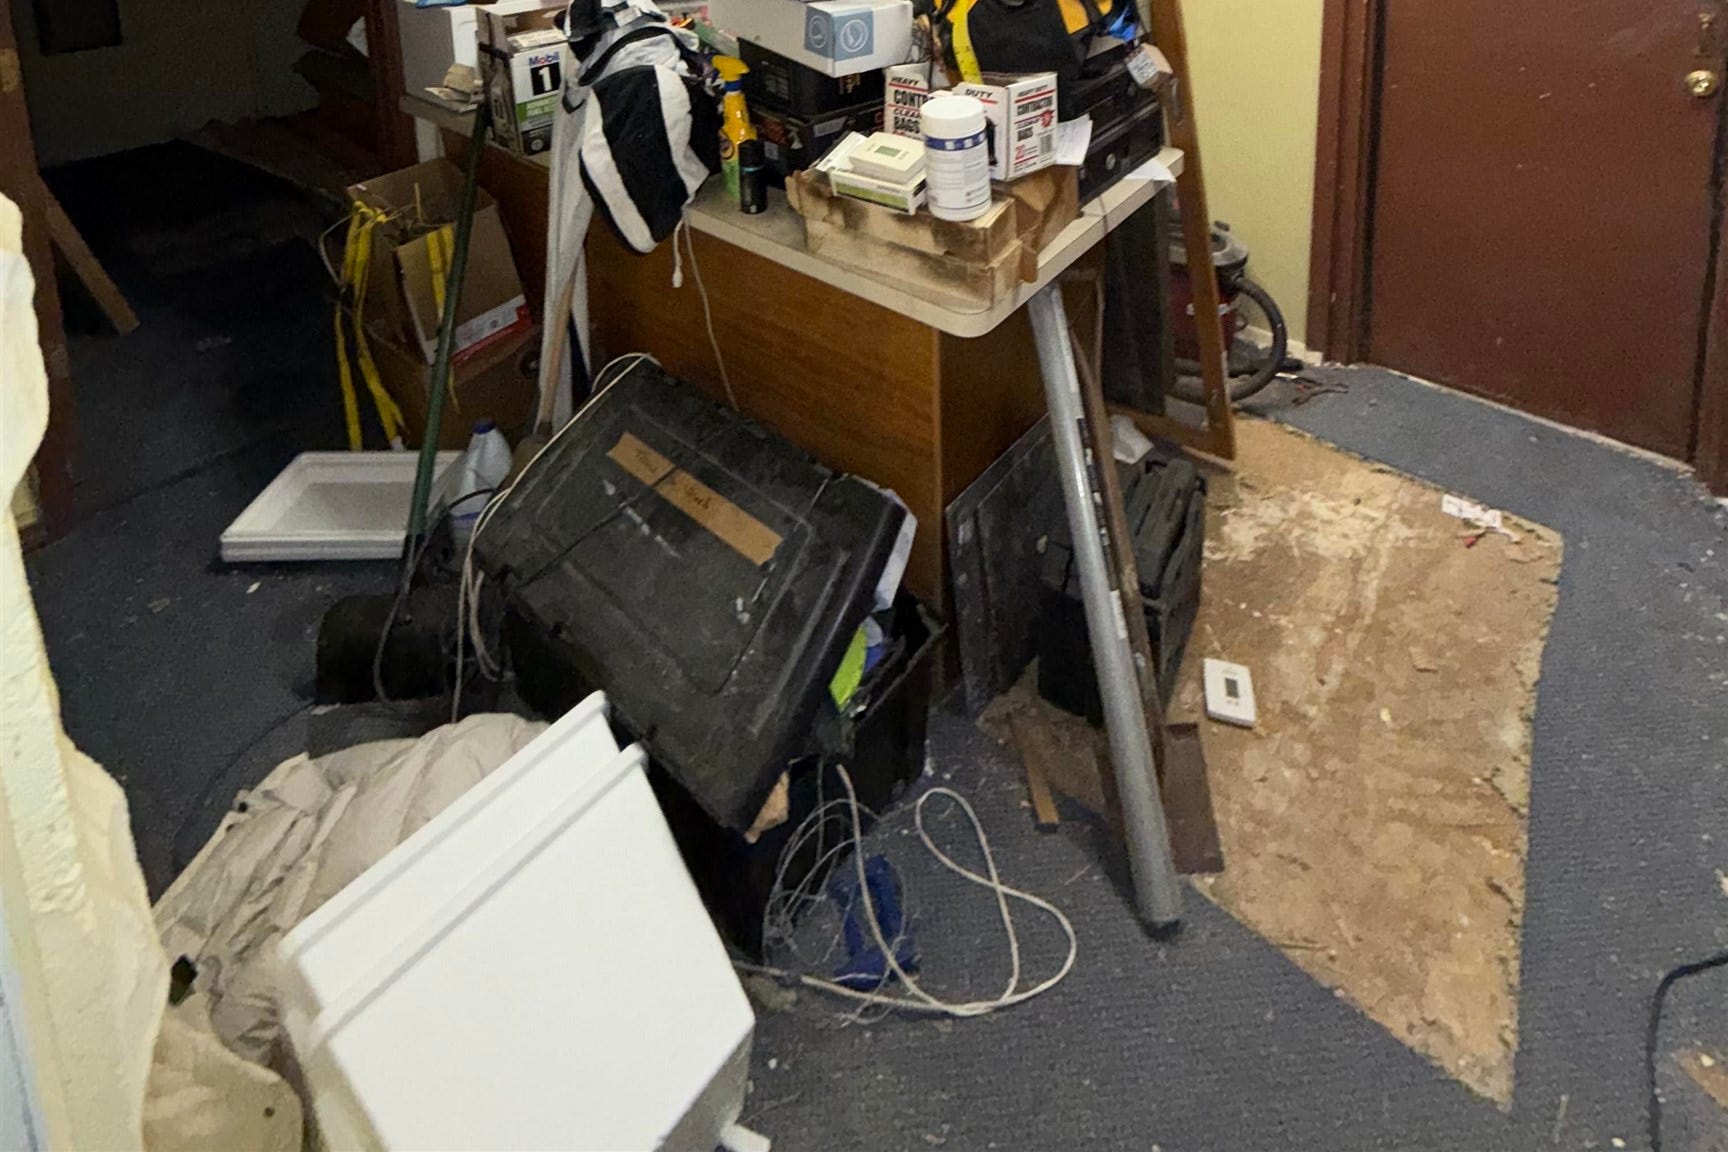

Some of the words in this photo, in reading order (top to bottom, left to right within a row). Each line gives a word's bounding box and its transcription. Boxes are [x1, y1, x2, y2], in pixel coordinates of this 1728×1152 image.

[528, 51, 560, 66] Mobil
[538, 66, 553, 92] 1
[890, 75, 920, 87] HEAVY
[964, 88, 995, 99] DUTY
[894, 116, 921, 135] BAGS
